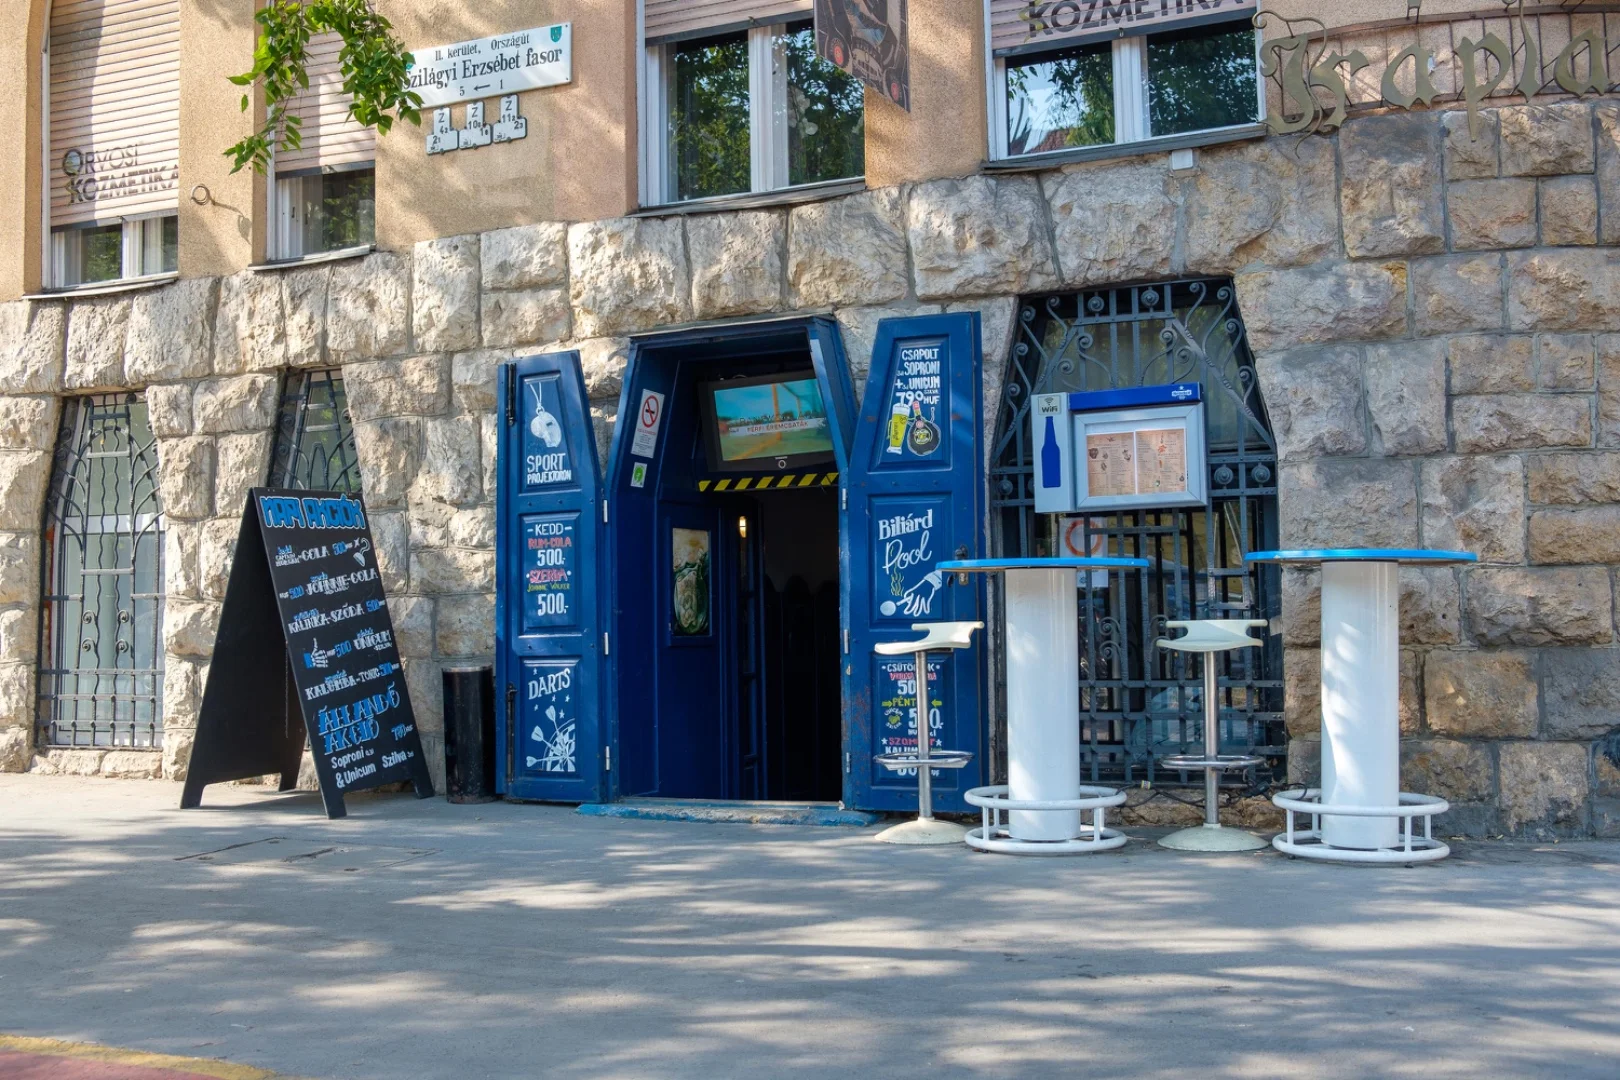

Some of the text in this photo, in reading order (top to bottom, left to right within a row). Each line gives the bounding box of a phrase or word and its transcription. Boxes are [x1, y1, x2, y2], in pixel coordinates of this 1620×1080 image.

[447, 43, 481, 59] kerület,
[490, 33, 530, 50] Országút
[403, 47, 563, 89] Szilágyi Erzsébet fasor
[459, 80, 504, 97] 5 1
[471, 107, 478, 118] Z
[505, 101, 512, 111] Z
[438, 112, 445, 123] Z
[62, 144, 138, 177] ORVOSI
[901, 348, 940, 360] CSAPOLT
[904, 361, 941, 376] SOPRONI
[908, 376, 941, 389] UNICUM
[895, 391, 940, 407] 790 HUF
[526, 453, 567, 473] SPORT
[527, 469, 572, 485] PROJEKTORON
[302, 494, 366, 529] AKCIÓK
[535, 523, 564, 536] KEDD
[878, 508, 933, 540] Biliárd
[527, 537, 572, 550] RUM-COLA
[882, 530, 933, 575] Pool
[288, 585, 305, 600] 500
[334, 640, 352, 658] 500
[353, 630, 392, 650] UNICUM
[528, 667, 571, 700] DARTS
[318, 682, 400, 735] ÁLLANDÓ
[331, 746, 364, 769] Soproni
[344, 763, 377, 783] Unicum
[382, 750, 407, 769] Szilva
